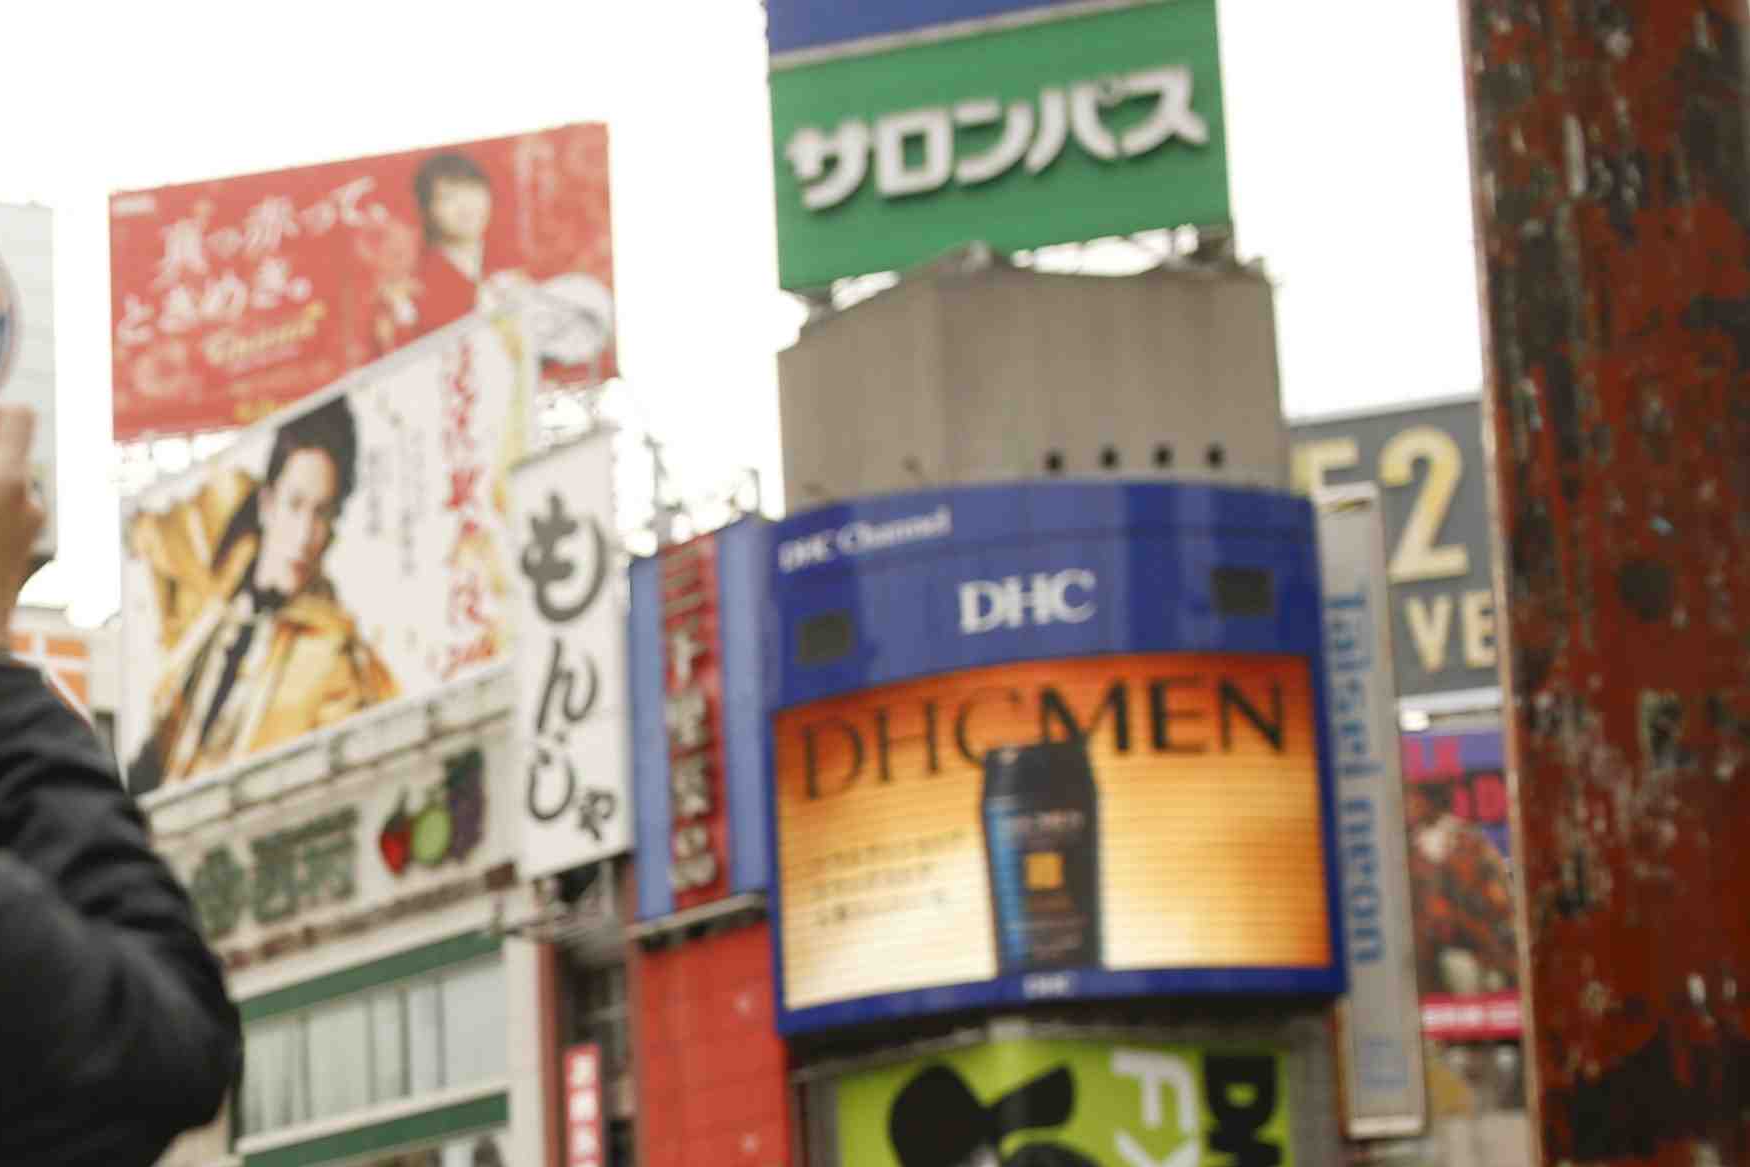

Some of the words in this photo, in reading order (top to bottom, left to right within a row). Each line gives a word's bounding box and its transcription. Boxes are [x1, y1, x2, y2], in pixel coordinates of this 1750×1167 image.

[785, 63, 1210, 212] サロンパス
[520, 490, 617, 842] もんじゃ
[957, 567, 1099, 634] DHC
